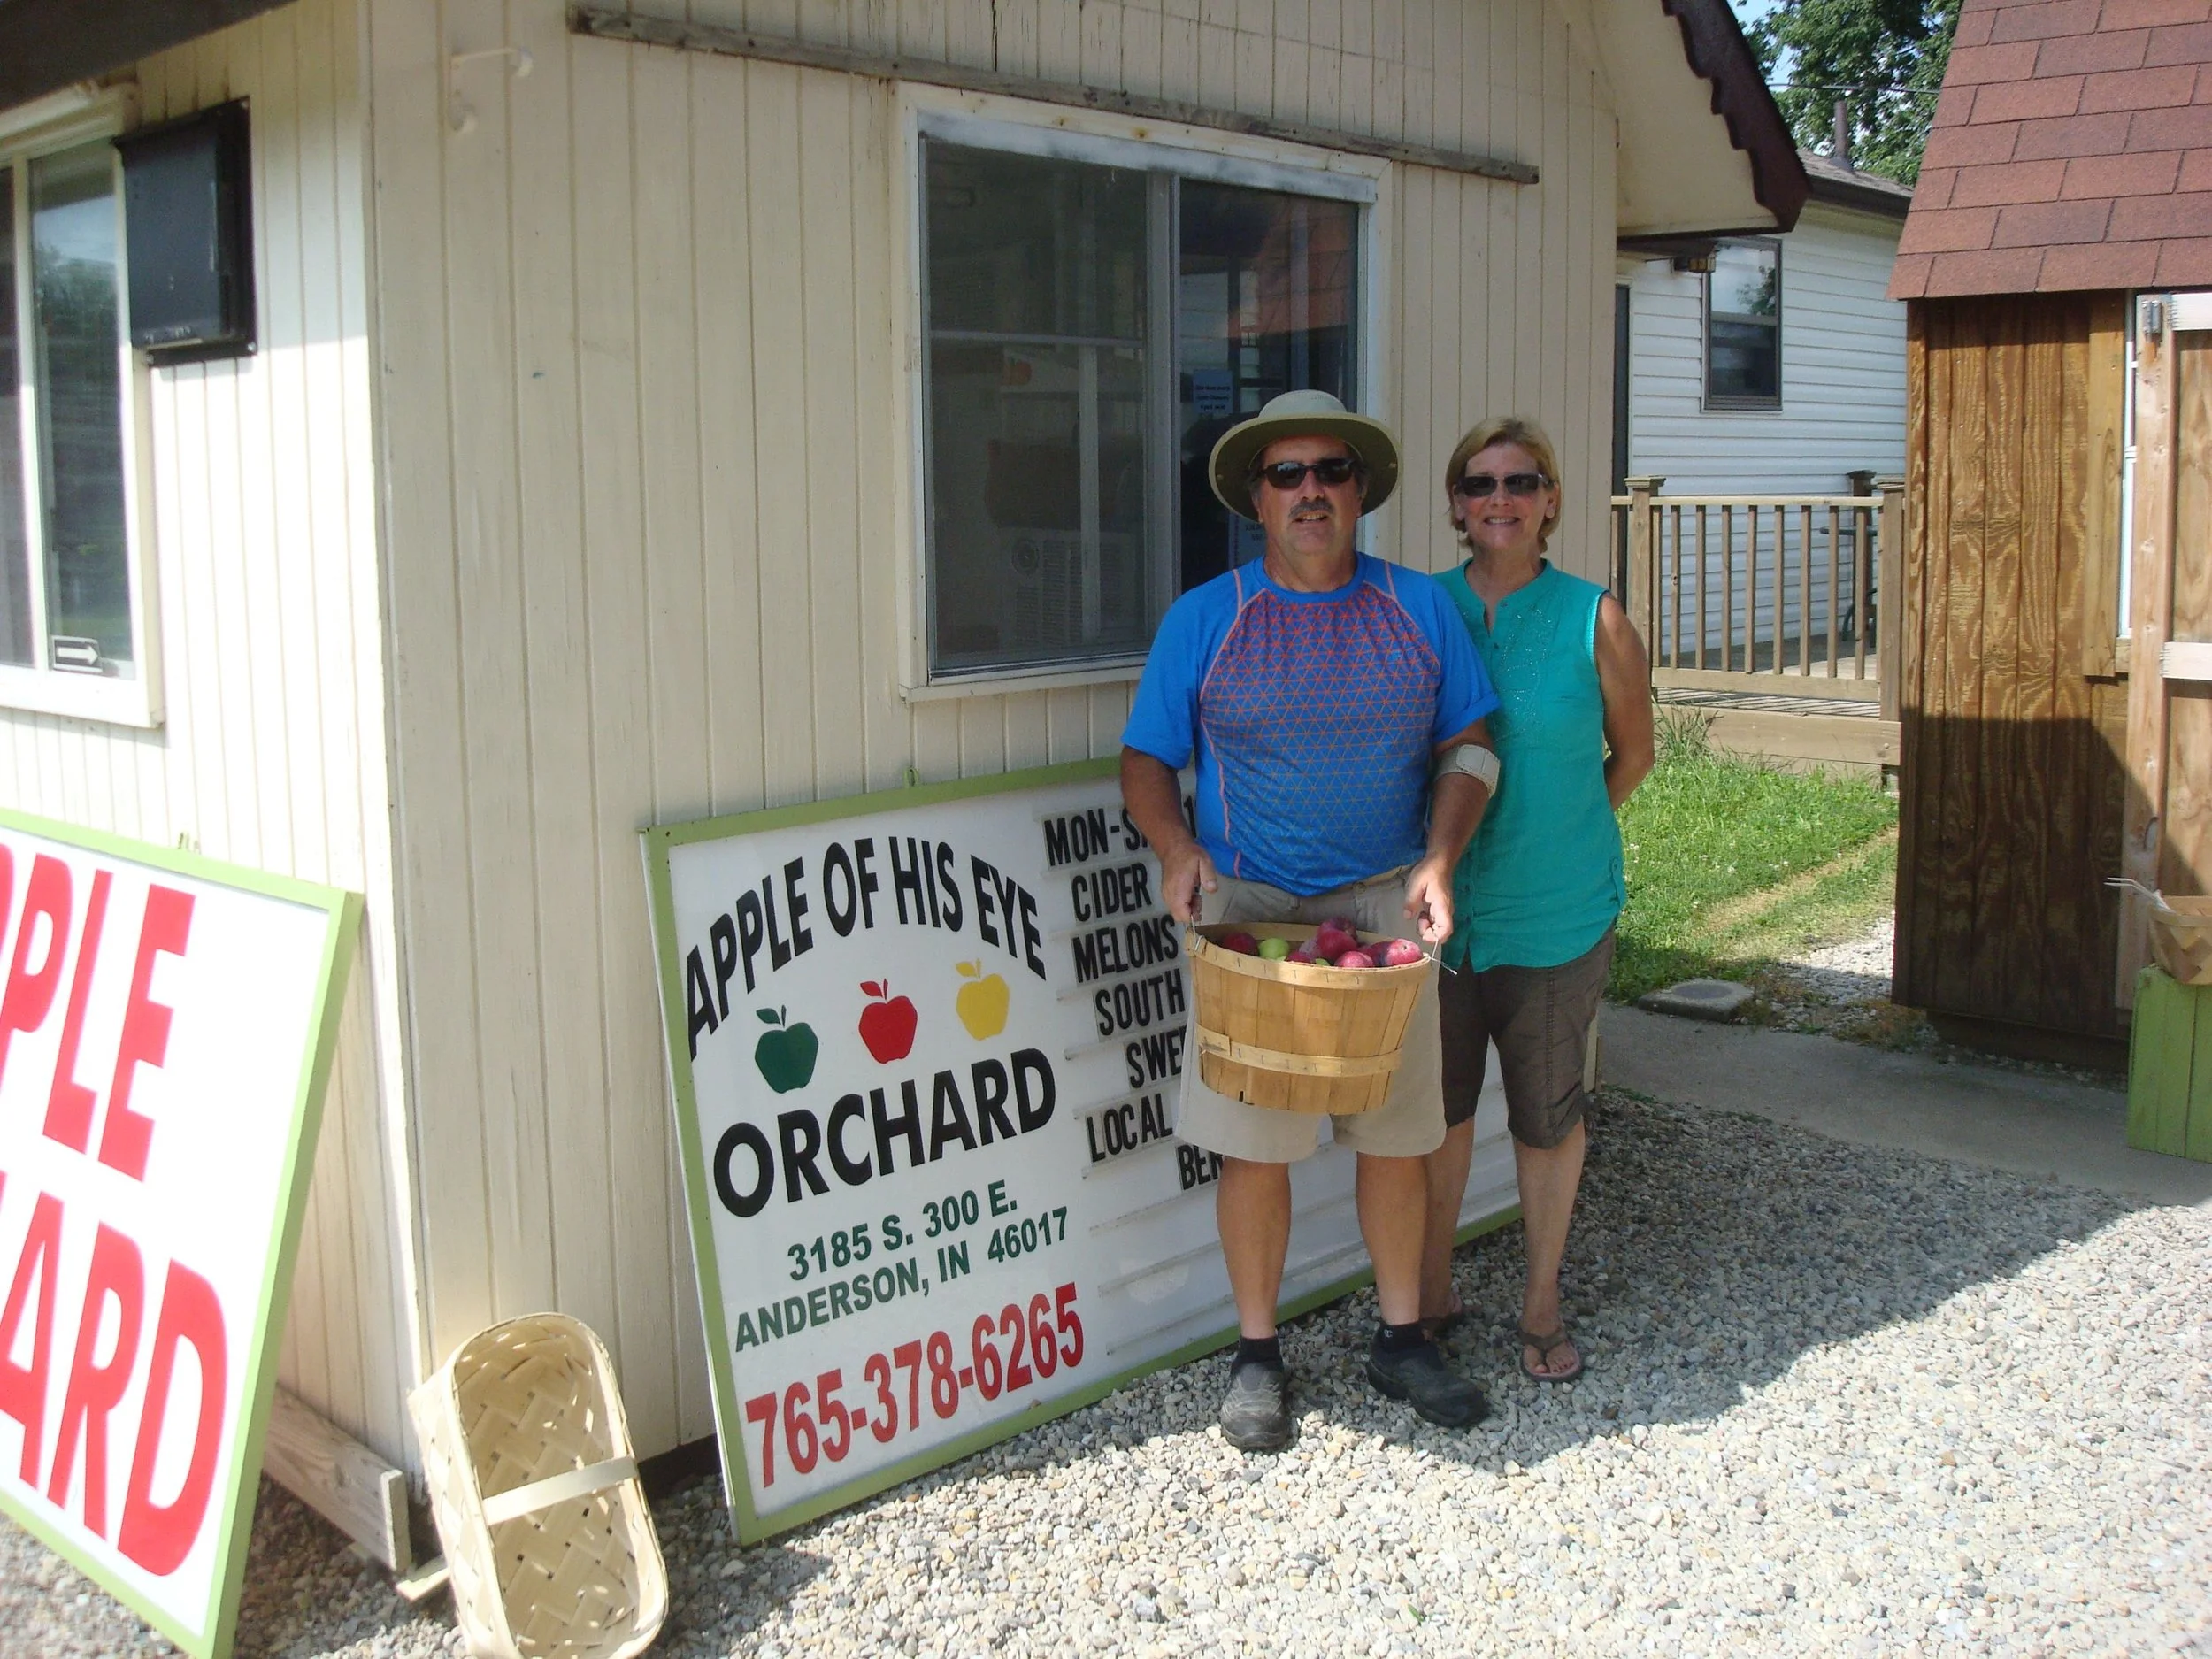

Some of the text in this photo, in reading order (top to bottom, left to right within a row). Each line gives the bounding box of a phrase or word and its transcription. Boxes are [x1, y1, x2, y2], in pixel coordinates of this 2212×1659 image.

[1044, 807, 1148, 866] MON-S
[1071, 862, 1152, 922] CIDER
[687, 835, 1047, 1063] APPLE OF HIS EYE
[1072, 913, 1179, 984] MELONS
[1094, 972, 1186, 1037] SOUTH
[0, 843, 196, 1184] PLE
[713, 1048, 1056, 1218] ORCHARD
[1087, 1093, 1173, 1164] LOCAL
[735, 1206, 1068, 1353] ANDERSON, IN 46017
[787, 1179, 1018, 1281] 3185 S. 300 E.
[0, 1170, 228, 1578] ARD
[745, 1281, 1085, 1488] 765-378-6265
